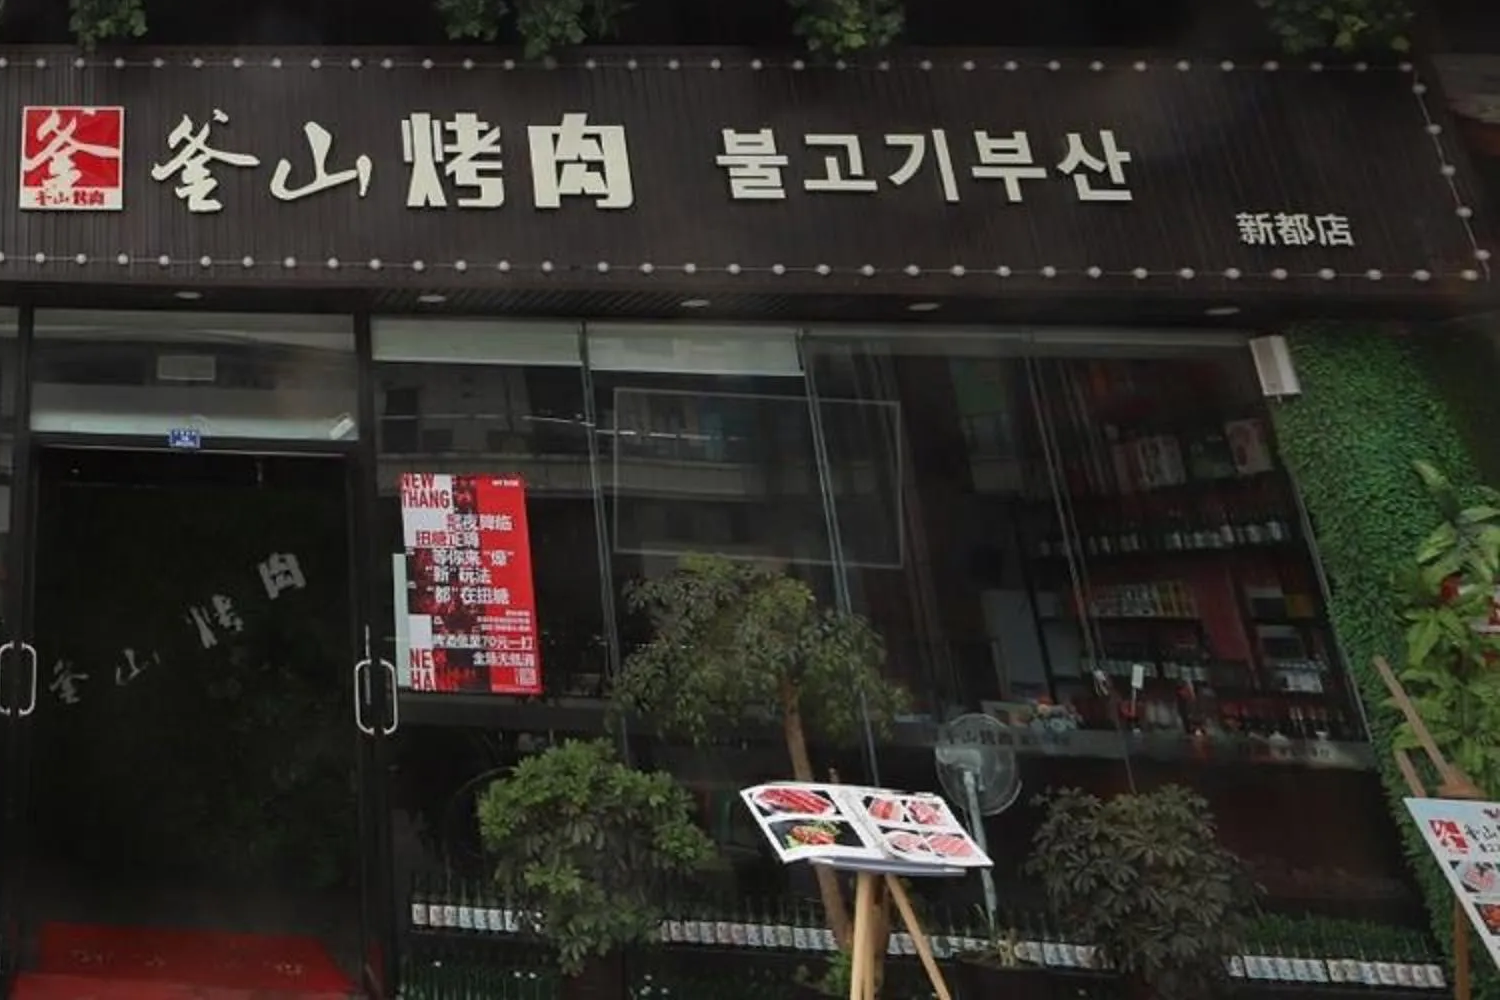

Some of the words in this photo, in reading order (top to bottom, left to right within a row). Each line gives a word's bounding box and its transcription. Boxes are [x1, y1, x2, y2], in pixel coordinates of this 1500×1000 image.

[151, 108, 635, 212] 釜山烤肉
[716, 127, 1133, 202] 불고기부산
[1236, 211, 1355, 247] 新都店
